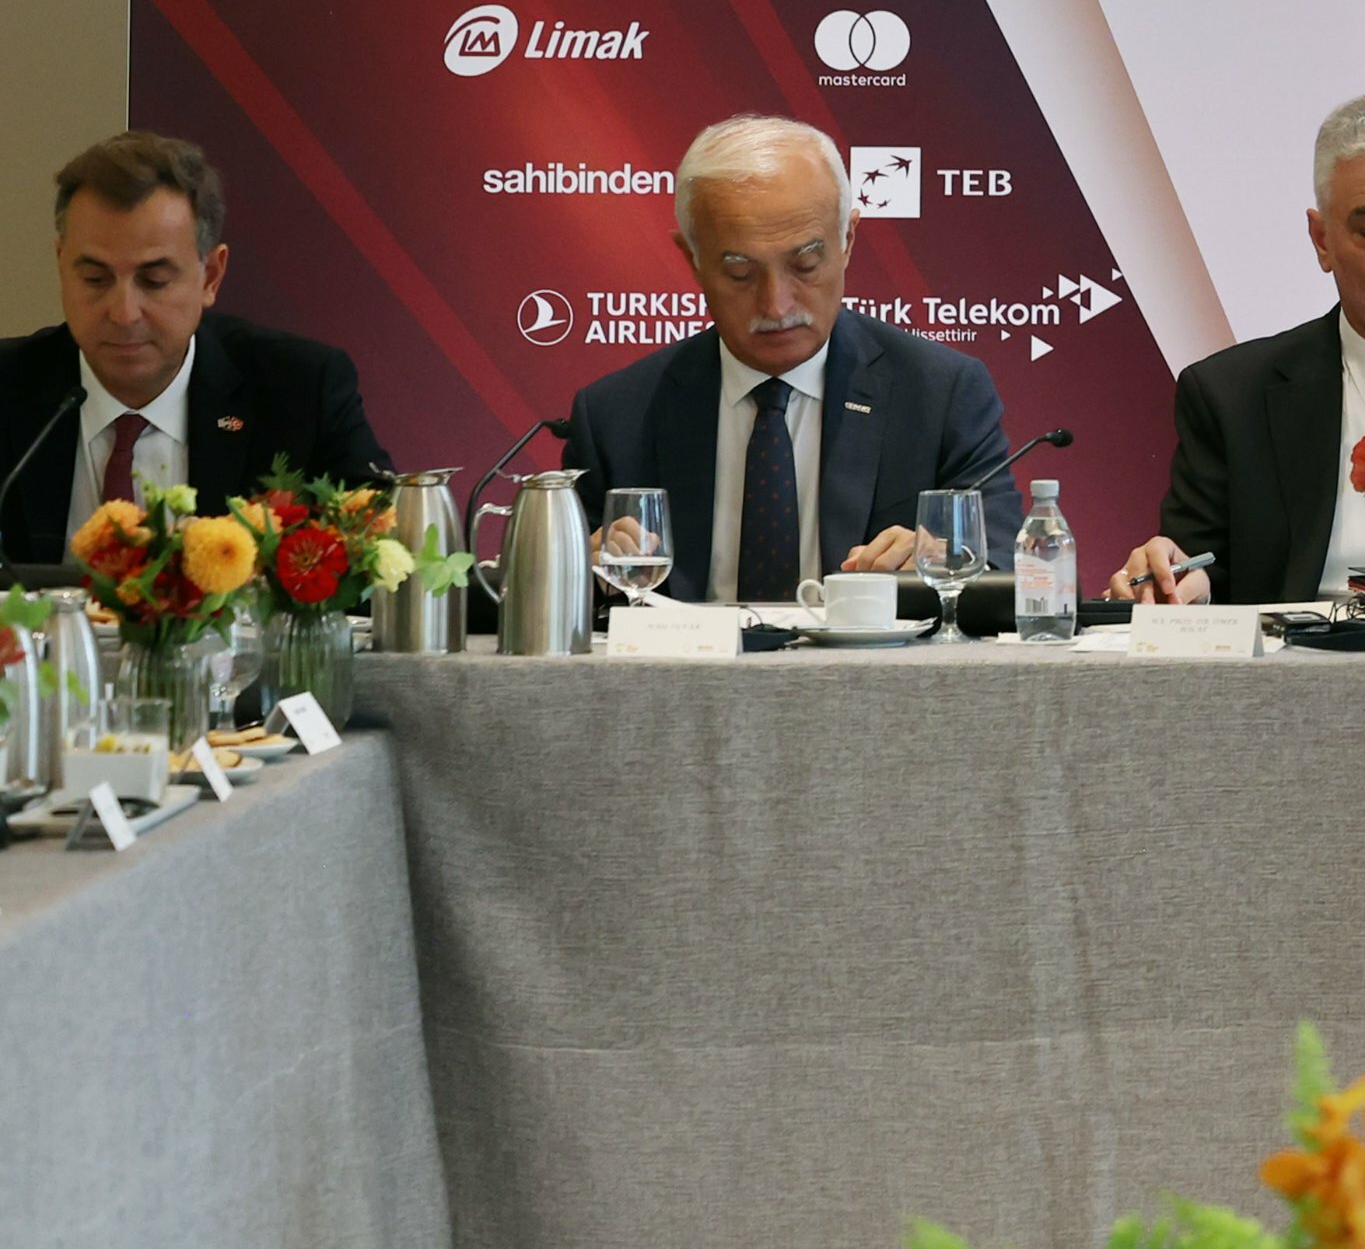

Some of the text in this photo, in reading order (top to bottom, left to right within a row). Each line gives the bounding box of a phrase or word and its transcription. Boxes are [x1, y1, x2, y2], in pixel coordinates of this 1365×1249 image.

[525, 21, 649, 59] Limak
[818, 71, 906, 87] mastercard
[483, 163, 675, 195] sahibinden
[937, 170, 1012, 195] TEB
[923, 297, 1060, 326] Telekom
[584, 320, 715, 345] AIRLINE
